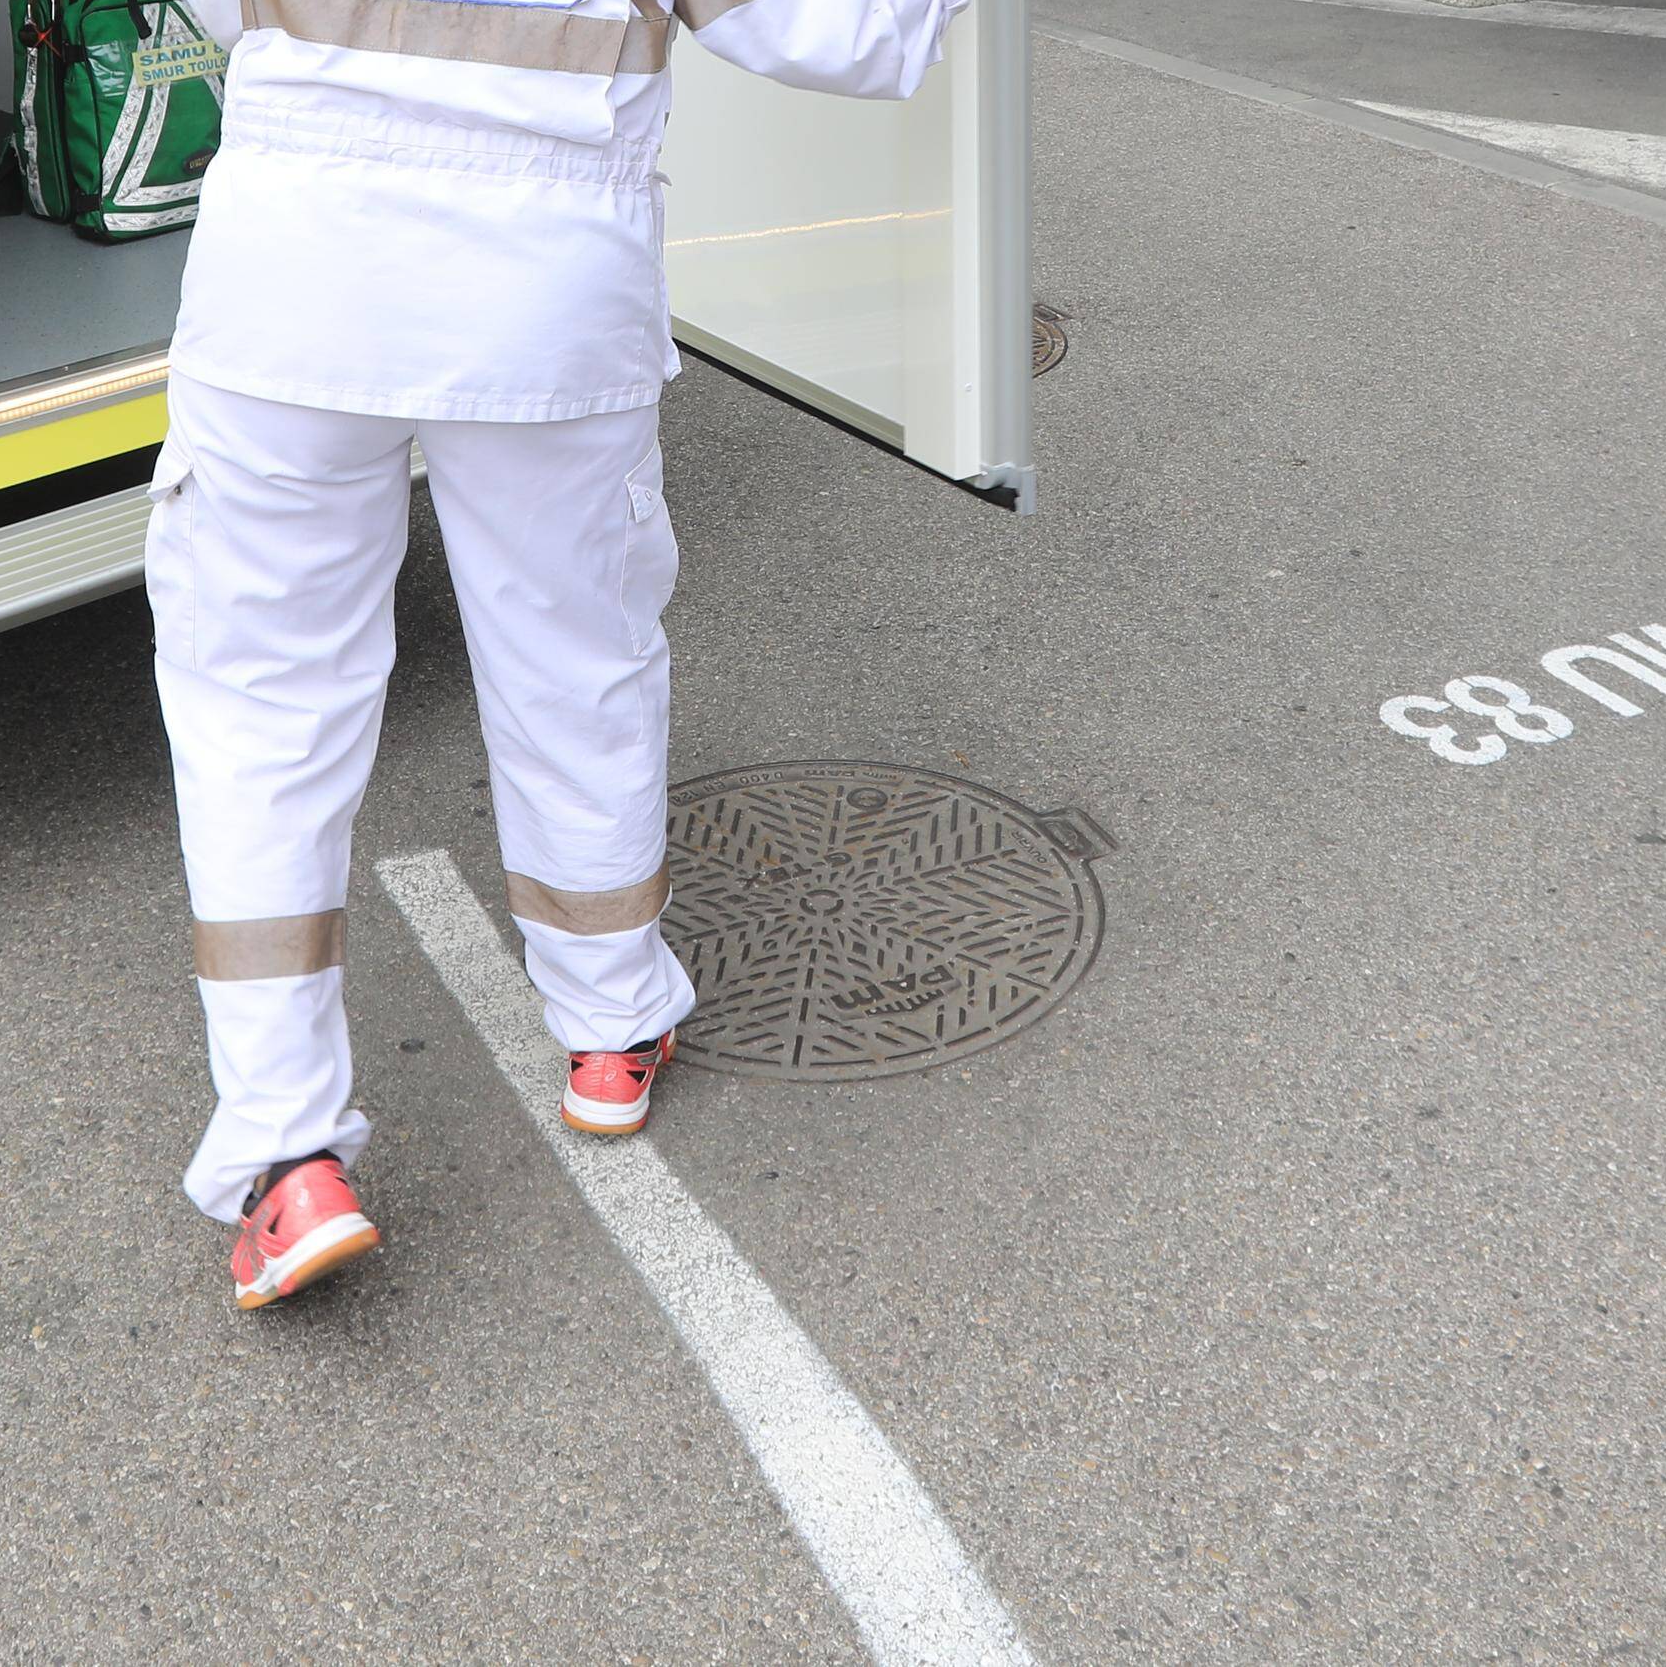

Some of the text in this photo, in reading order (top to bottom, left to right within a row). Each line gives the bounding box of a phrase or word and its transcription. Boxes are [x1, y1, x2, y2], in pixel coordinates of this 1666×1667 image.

[140, 45, 206, 66] SAMU
[142, 56, 229, 82] SMUR TOULO
[1378, 674, 1574, 766] 83
